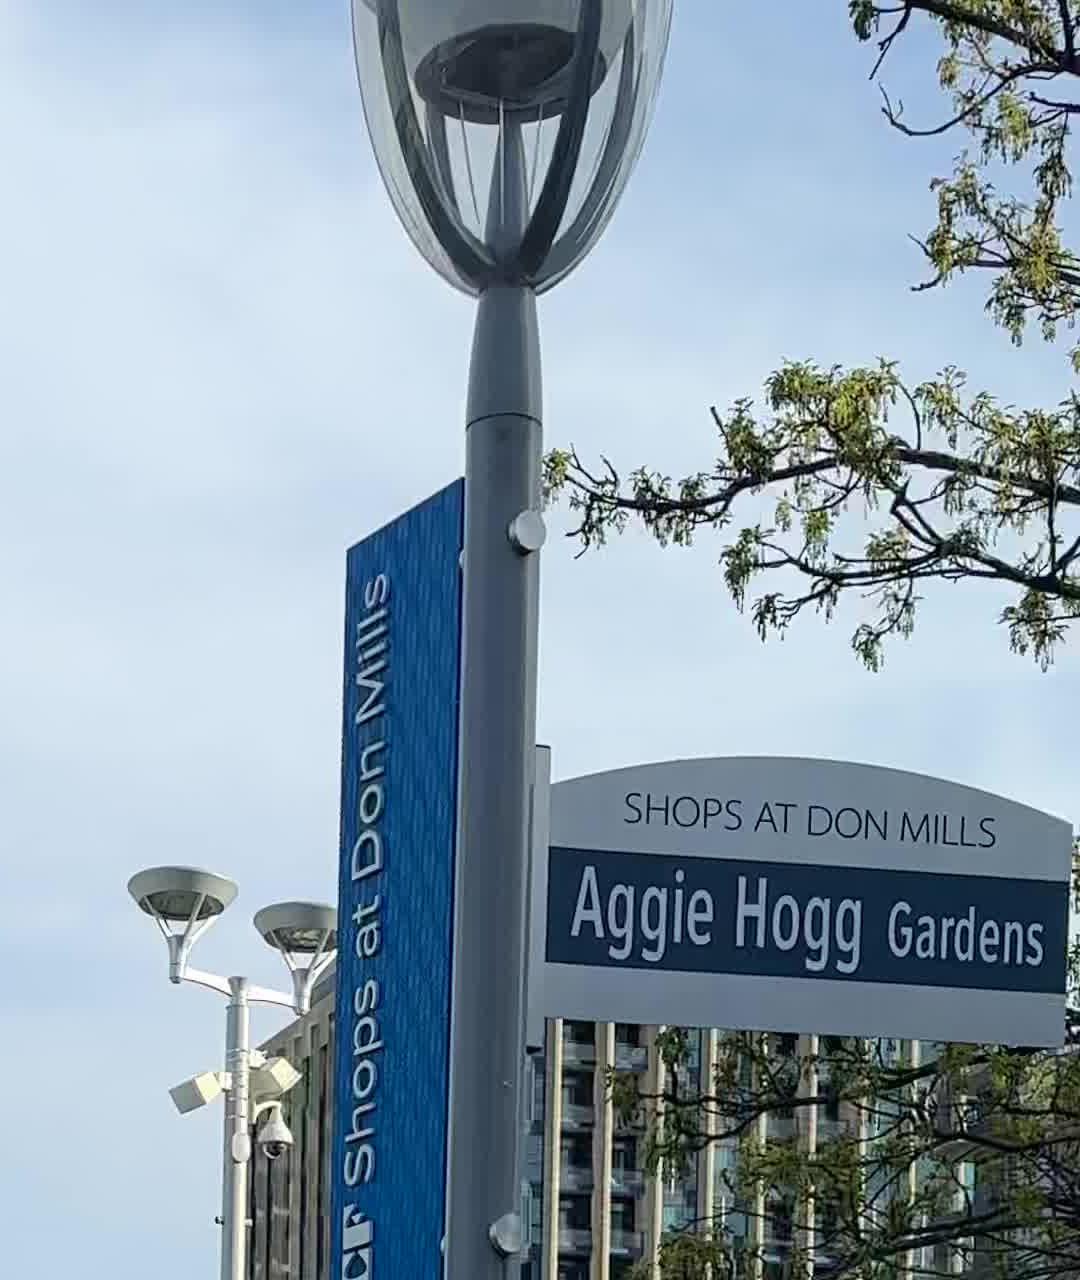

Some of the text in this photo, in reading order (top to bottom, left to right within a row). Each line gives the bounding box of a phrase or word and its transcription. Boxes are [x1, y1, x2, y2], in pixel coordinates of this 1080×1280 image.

[355, 573, 391, 725] Mills
[351, 741, 387, 881] Don
[623, 792, 997, 848] SHOPS AT DON MILLS
[351, 894, 380, 960] at
[571, 865, 1045, 974] Aggie Hogg Gardens
[344, 979, 384, 1187] Shops
